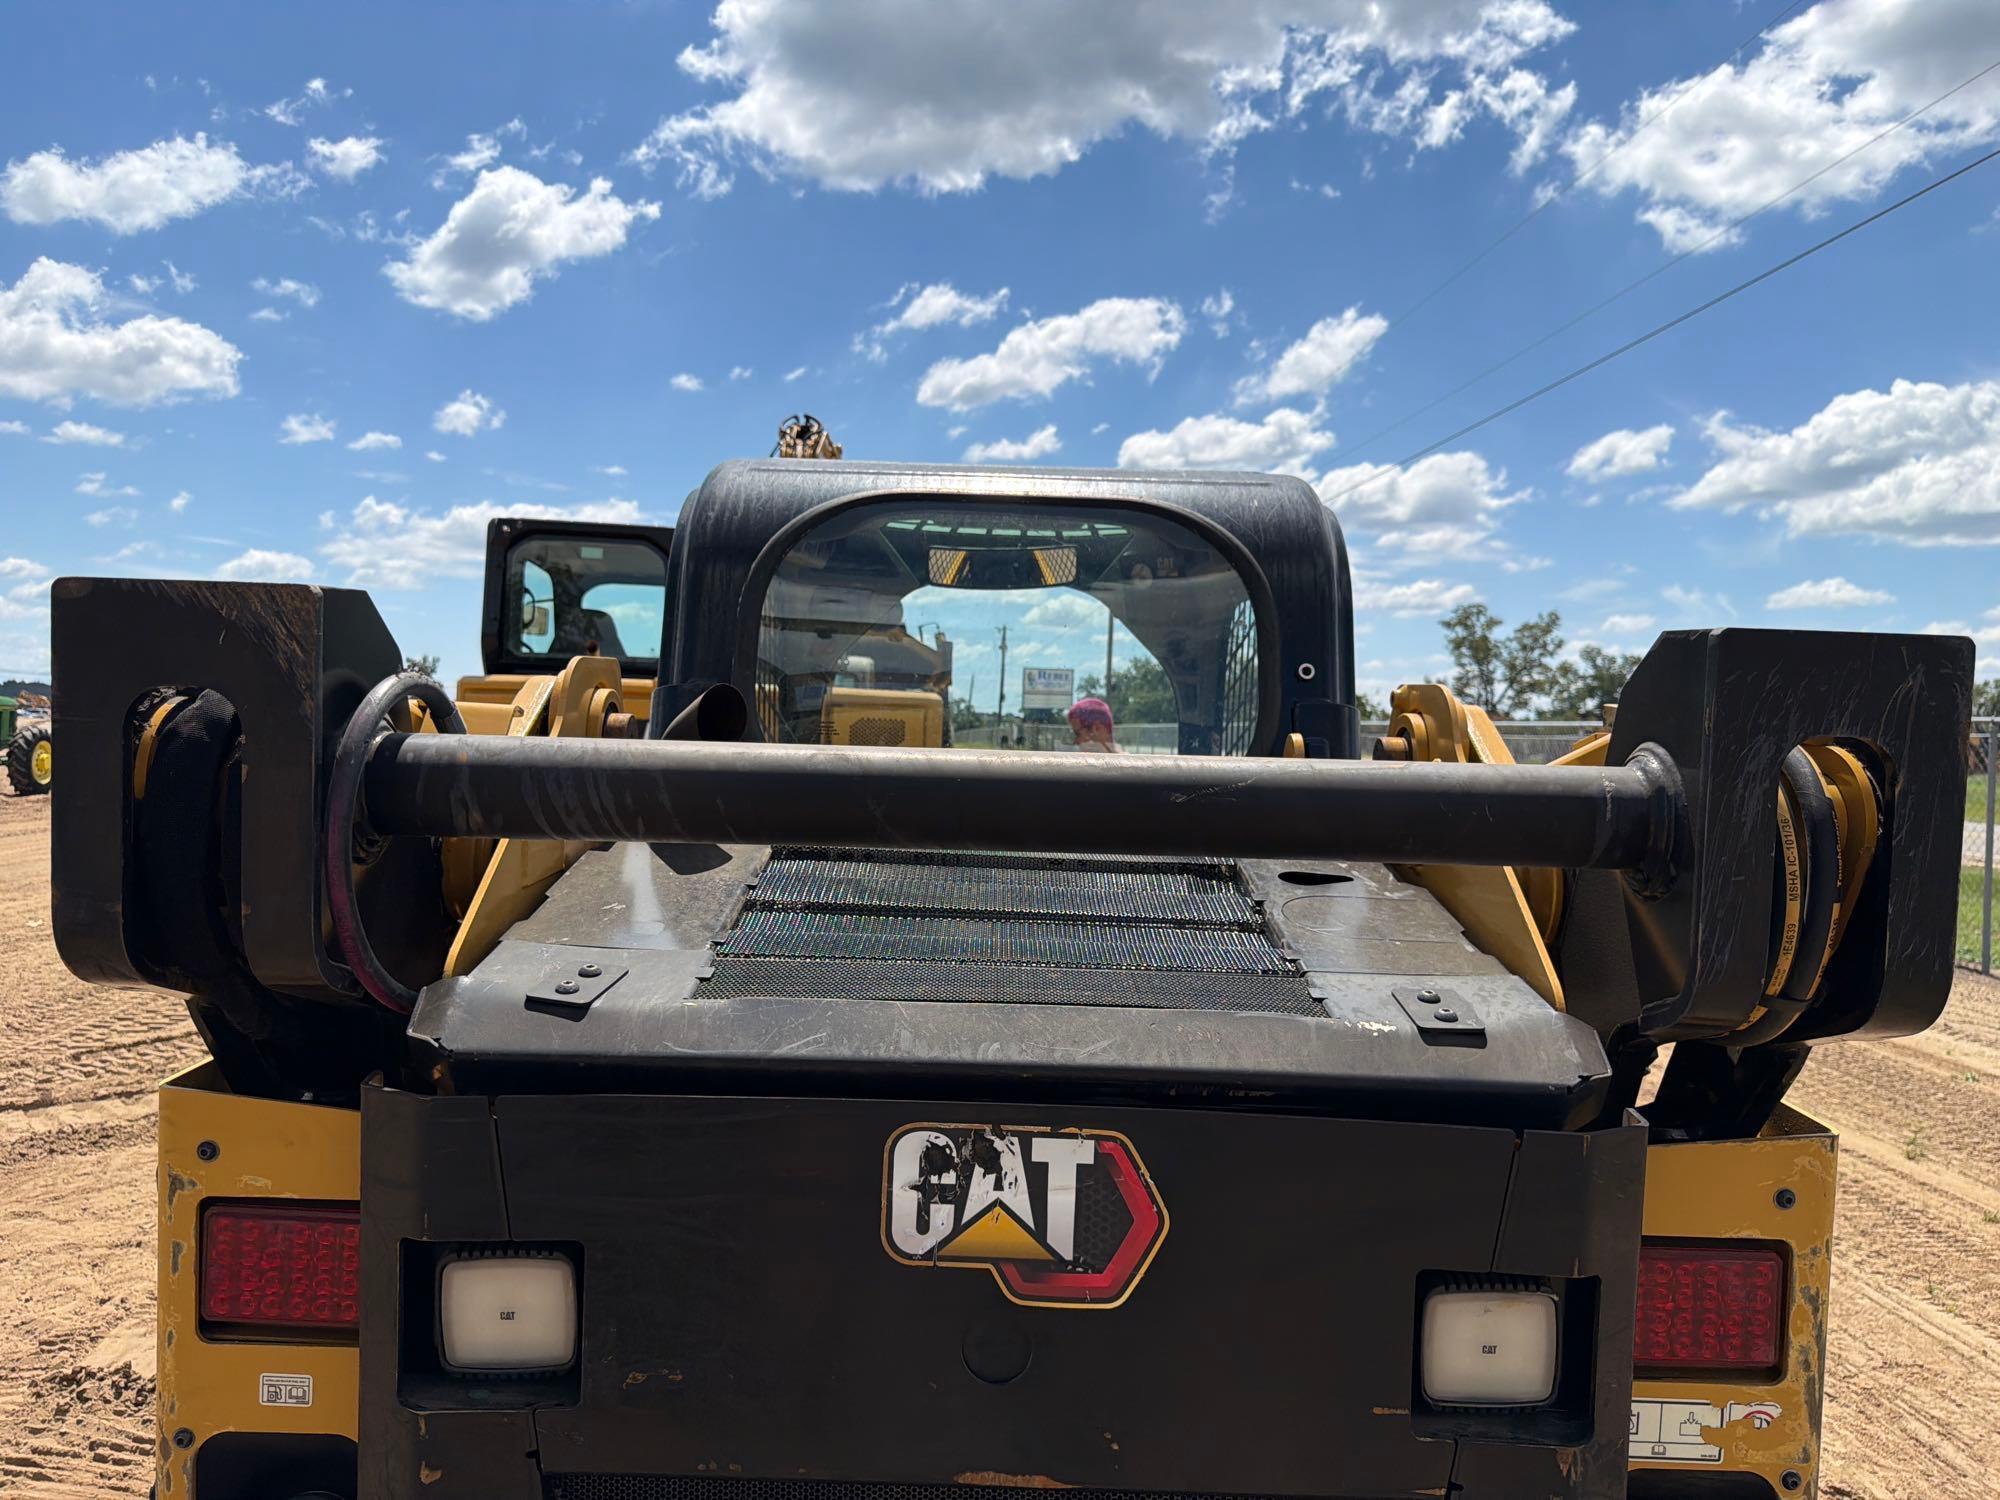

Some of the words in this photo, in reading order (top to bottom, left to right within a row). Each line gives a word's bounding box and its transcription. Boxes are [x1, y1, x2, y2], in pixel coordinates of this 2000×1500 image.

[1788, 869, 1800, 902] MSHA
[1782, 923, 1797, 956] 1E4639
[891, 1130, 1095, 1261] CAT
[500, 1311, 516, 1321] CAT
[1482, 1345, 1498, 1355] CAT
